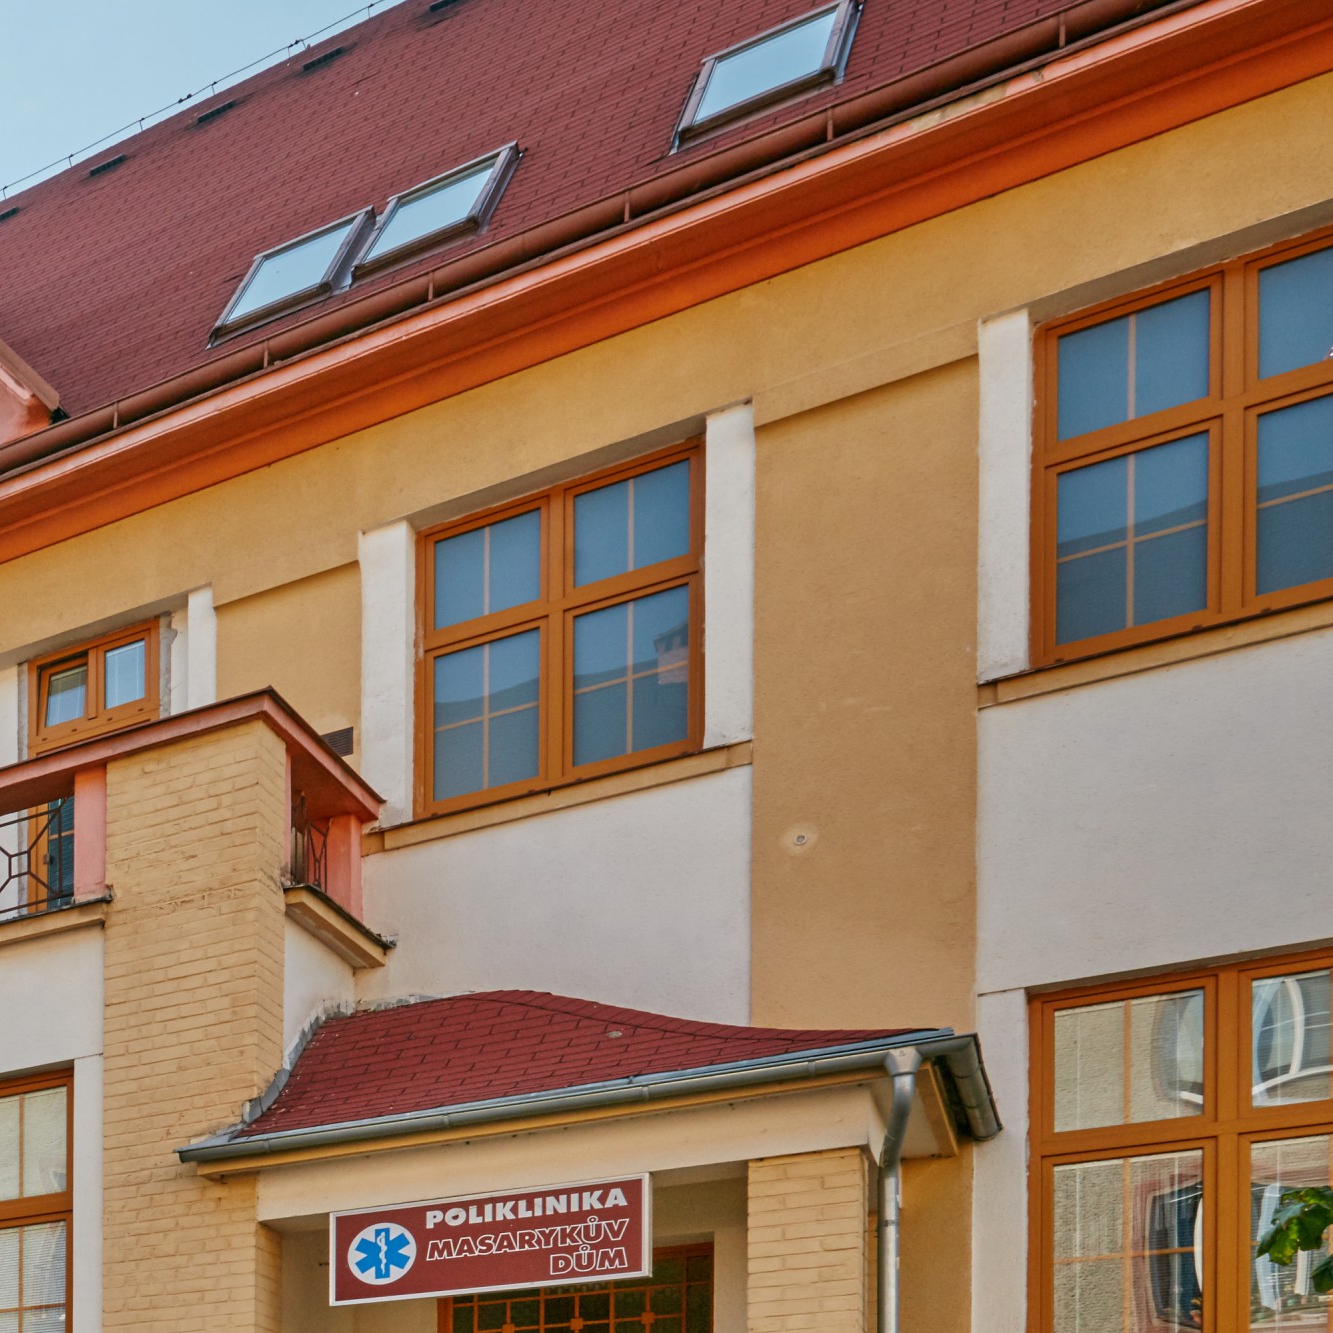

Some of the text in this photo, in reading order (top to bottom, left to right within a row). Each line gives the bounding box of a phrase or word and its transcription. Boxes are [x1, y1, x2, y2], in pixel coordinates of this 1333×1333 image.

[425, 1187, 628, 1229] POLIKLINIKA
[426, 1215, 630, 1261] MASARYKŮV
[550, 1244, 628, 1275] DŮM
